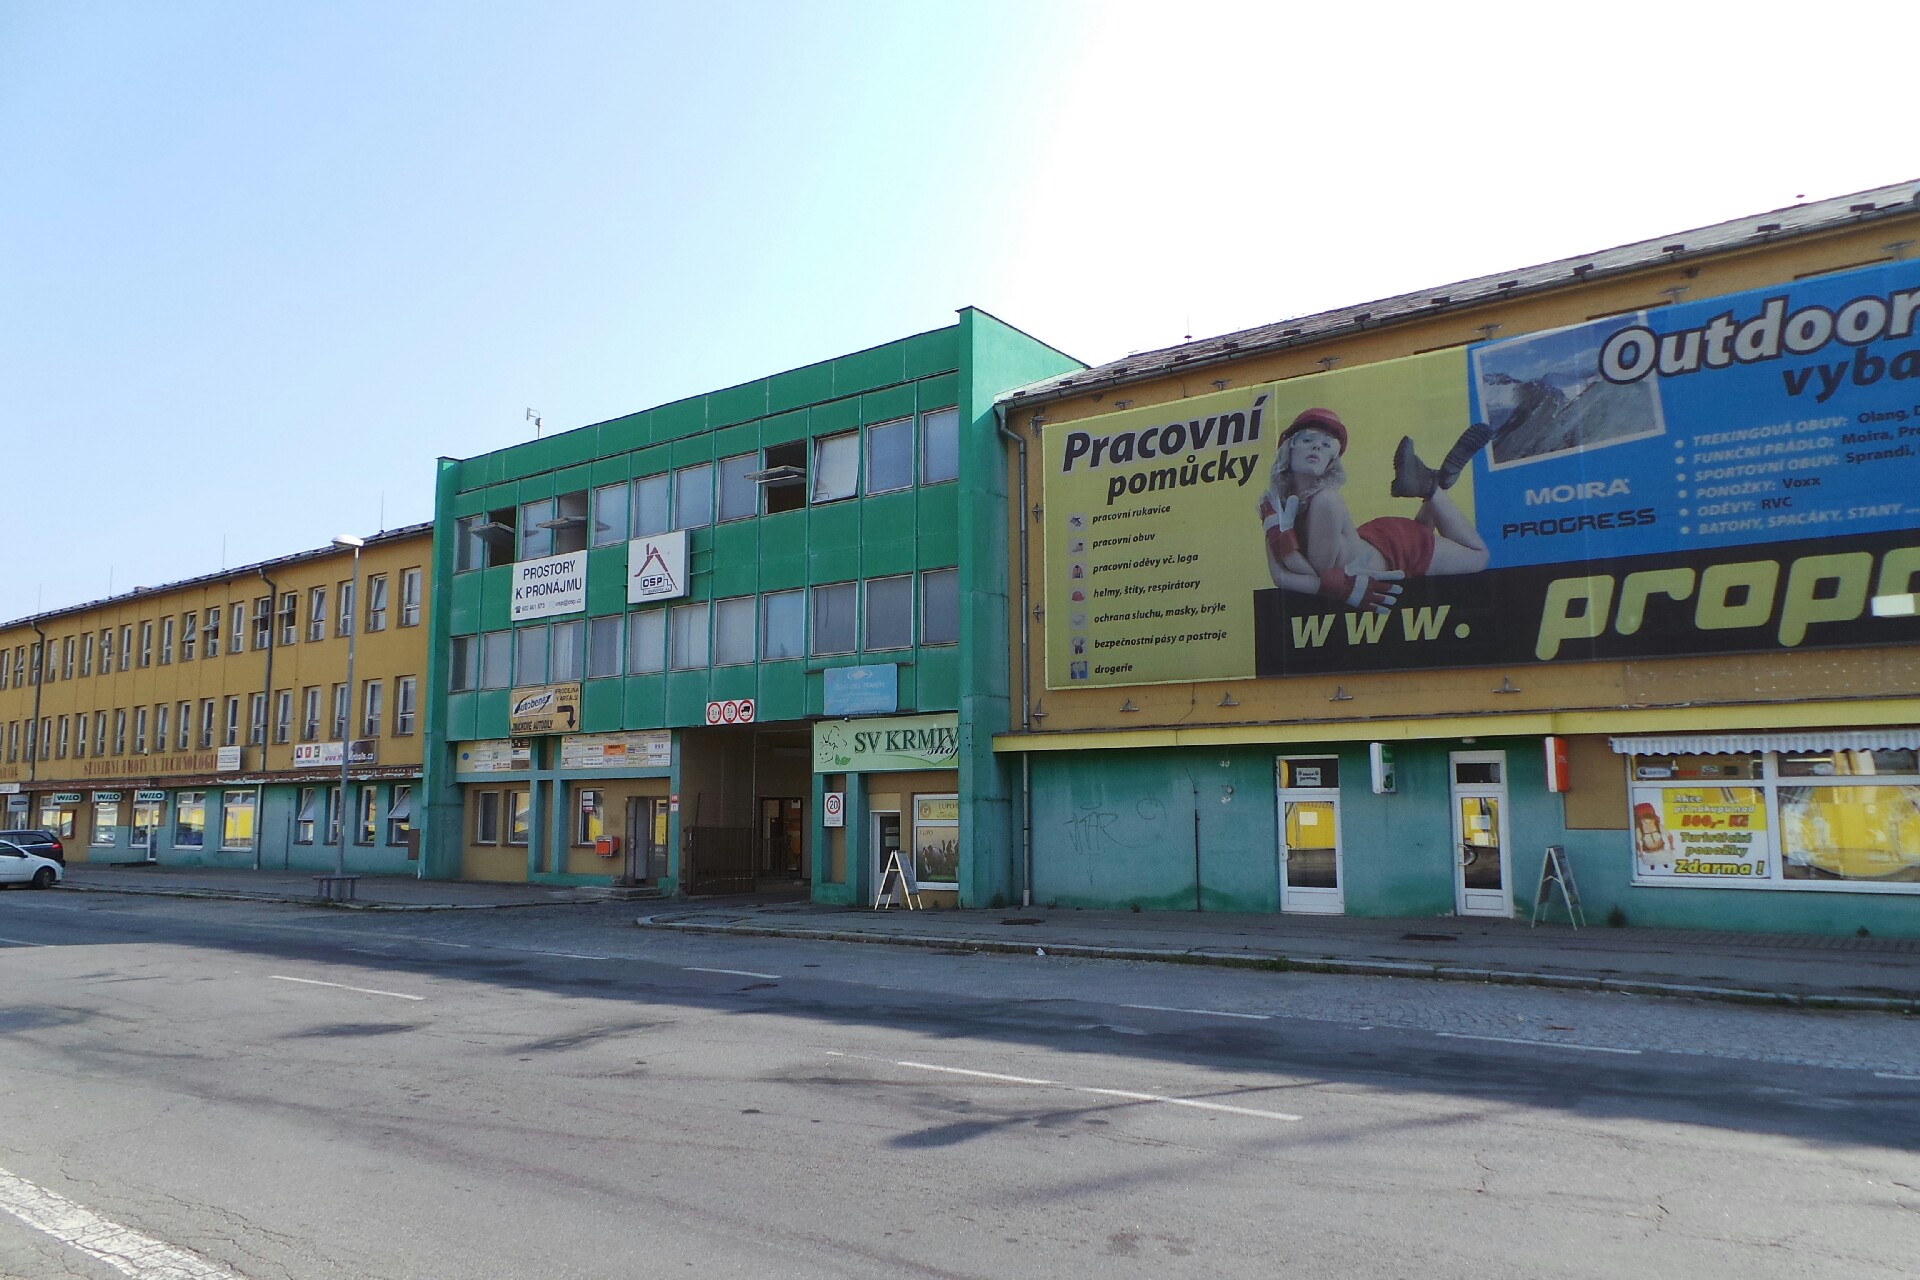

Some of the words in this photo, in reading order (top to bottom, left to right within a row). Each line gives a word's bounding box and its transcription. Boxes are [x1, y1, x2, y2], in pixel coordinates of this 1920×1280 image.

[1600, 286, 1920, 385] Outdoor
[1062, 395, 1268, 472] Pracovní
[1693, 425, 1793, 447] TREKINGOVÁ
[1795, 417, 1848, 432] OBUV:
[1858, 409, 1910, 424] Olang,
[1764, 437, 1835, 457] PRÁDLO:
[1842, 428, 1893, 445] Moira,
[1107, 450, 1259, 505] pomůcky
[1695, 461, 1784, 482] SPORTOVNÍ
[1788, 454, 1839, 471] OBUV:
[1525, 478, 1630, 506] MOIRA
[1696, 481, 1776, 499] PONOŽKY:
[1782, 477, 1821, 489] Voxx
[1761, 497, 1792, 510] RVC
[1092, 507, 1131, 525] pracovní
[1132, 504, 1171, 517] rukavice
[1503, 508, 1656, 540] PROGRESS
[1698, 518, 1764, 535] BATOHY,
[1848, 503, 1903, 520] STANY
[1092, 534, 1131, 549] pracovní
[1132, 532, 1156, 543] obuv
[523, 560, 576, 580] PROSTORY
[1093, 559, 1131, 574] pracovní
[1133, 556, 1161, 570] oděvy
[1162, 554, 1175, 565] vč.
[1177, 553, 1198, 566] loga
[515, 587, 523, 600] K
[526, 577, 582, 598] PRONÁJMU
[643, 577, 663, 588] OSP
[1093, 586, 1123, 599] helmy,
[1124, 583, 1147, 596] štíty,
[1148, 578, 1201, 595] respirátory
[1094, 611, 1130, 624] ochrana
[1132, 608, 1163, 620] sluchu,
[1165, 604, 1199, 618] masky,
[1201, 602, 1226, 615] brýle
[1095, 633, 1153, 649] bezpečnostní
[1155, 632, 1177, 646] pásy
[1178, 634, 1185, 642] a
[1186, 629, 1227, 644] postroje
[1095, 662, 1133, 676] drogerie
[855, 731, 882, 754] SV
[56, 793, 80, 801] WILO
[830, 801, 838, 810] 20
[1674, 794, 1703, 803] Akce
[1735, 805, 1755, 813] nad
[1685, 844, 1749, 858] ponožky
[1674, 859, 1752, 875] Zdarma
[1756, 860, 1765, 875] !
